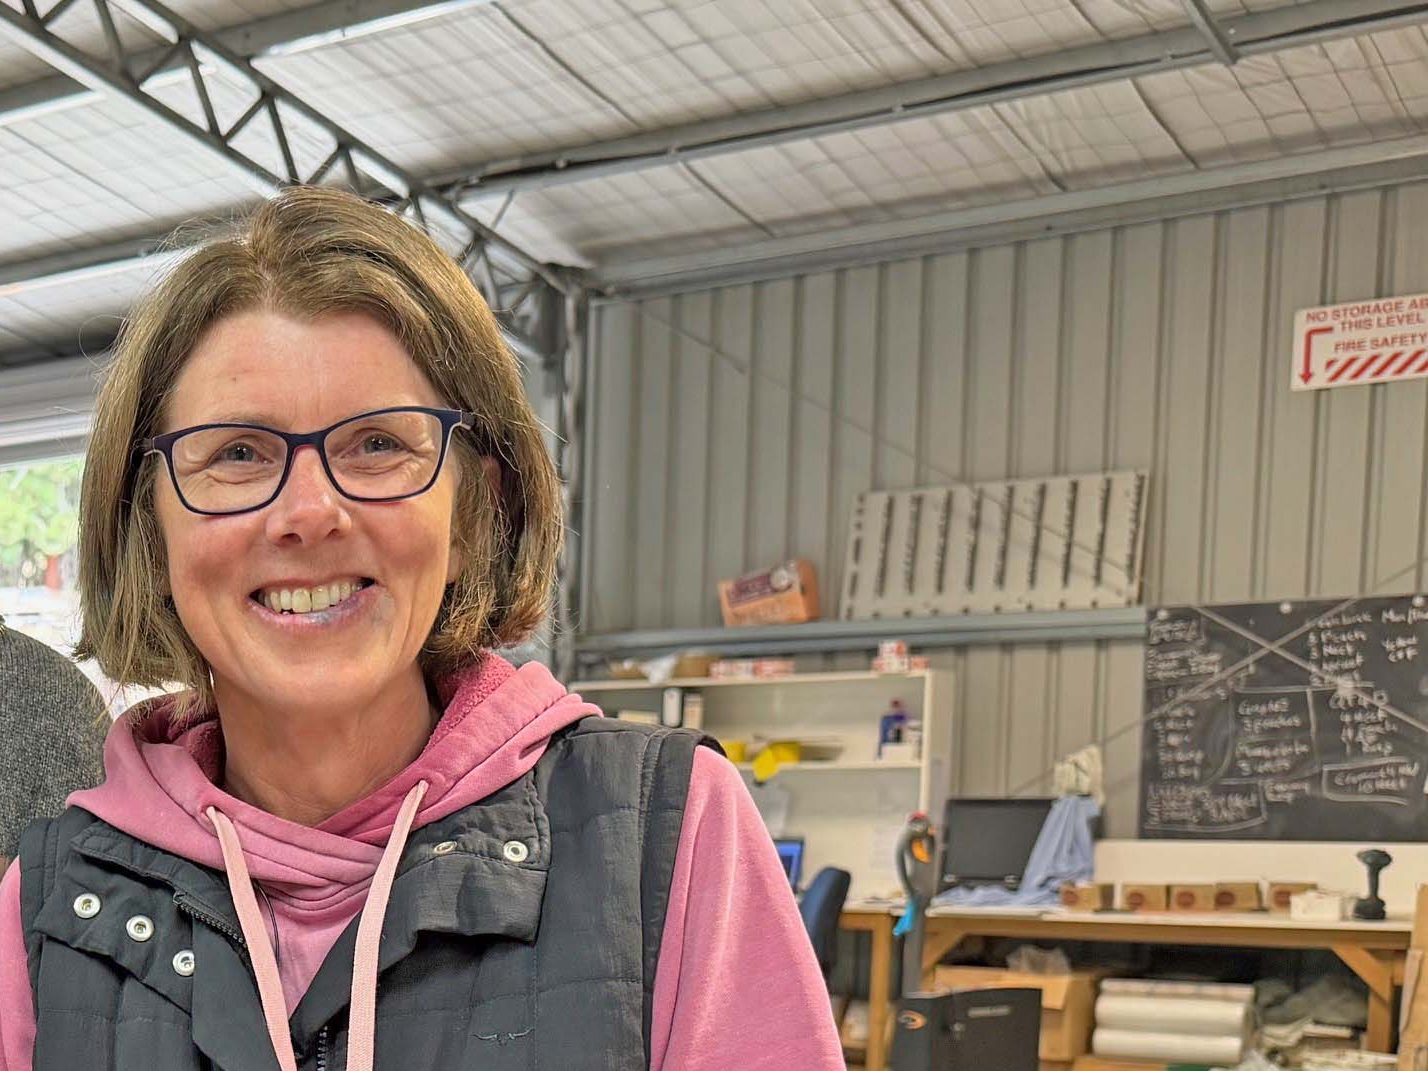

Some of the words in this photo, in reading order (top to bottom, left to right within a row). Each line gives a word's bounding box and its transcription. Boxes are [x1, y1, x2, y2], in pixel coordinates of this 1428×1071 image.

[1306, 311, 1328, 323] NO
[1332, 300, 1404, 320] STORAGE
[1340, 319, 1373, 332] THIS
[1377, 312, 1424, 328] LEVEL
[1334, 339, 1367, 352] FIRE
[1371, 332, 1427, 350] SAFETY
